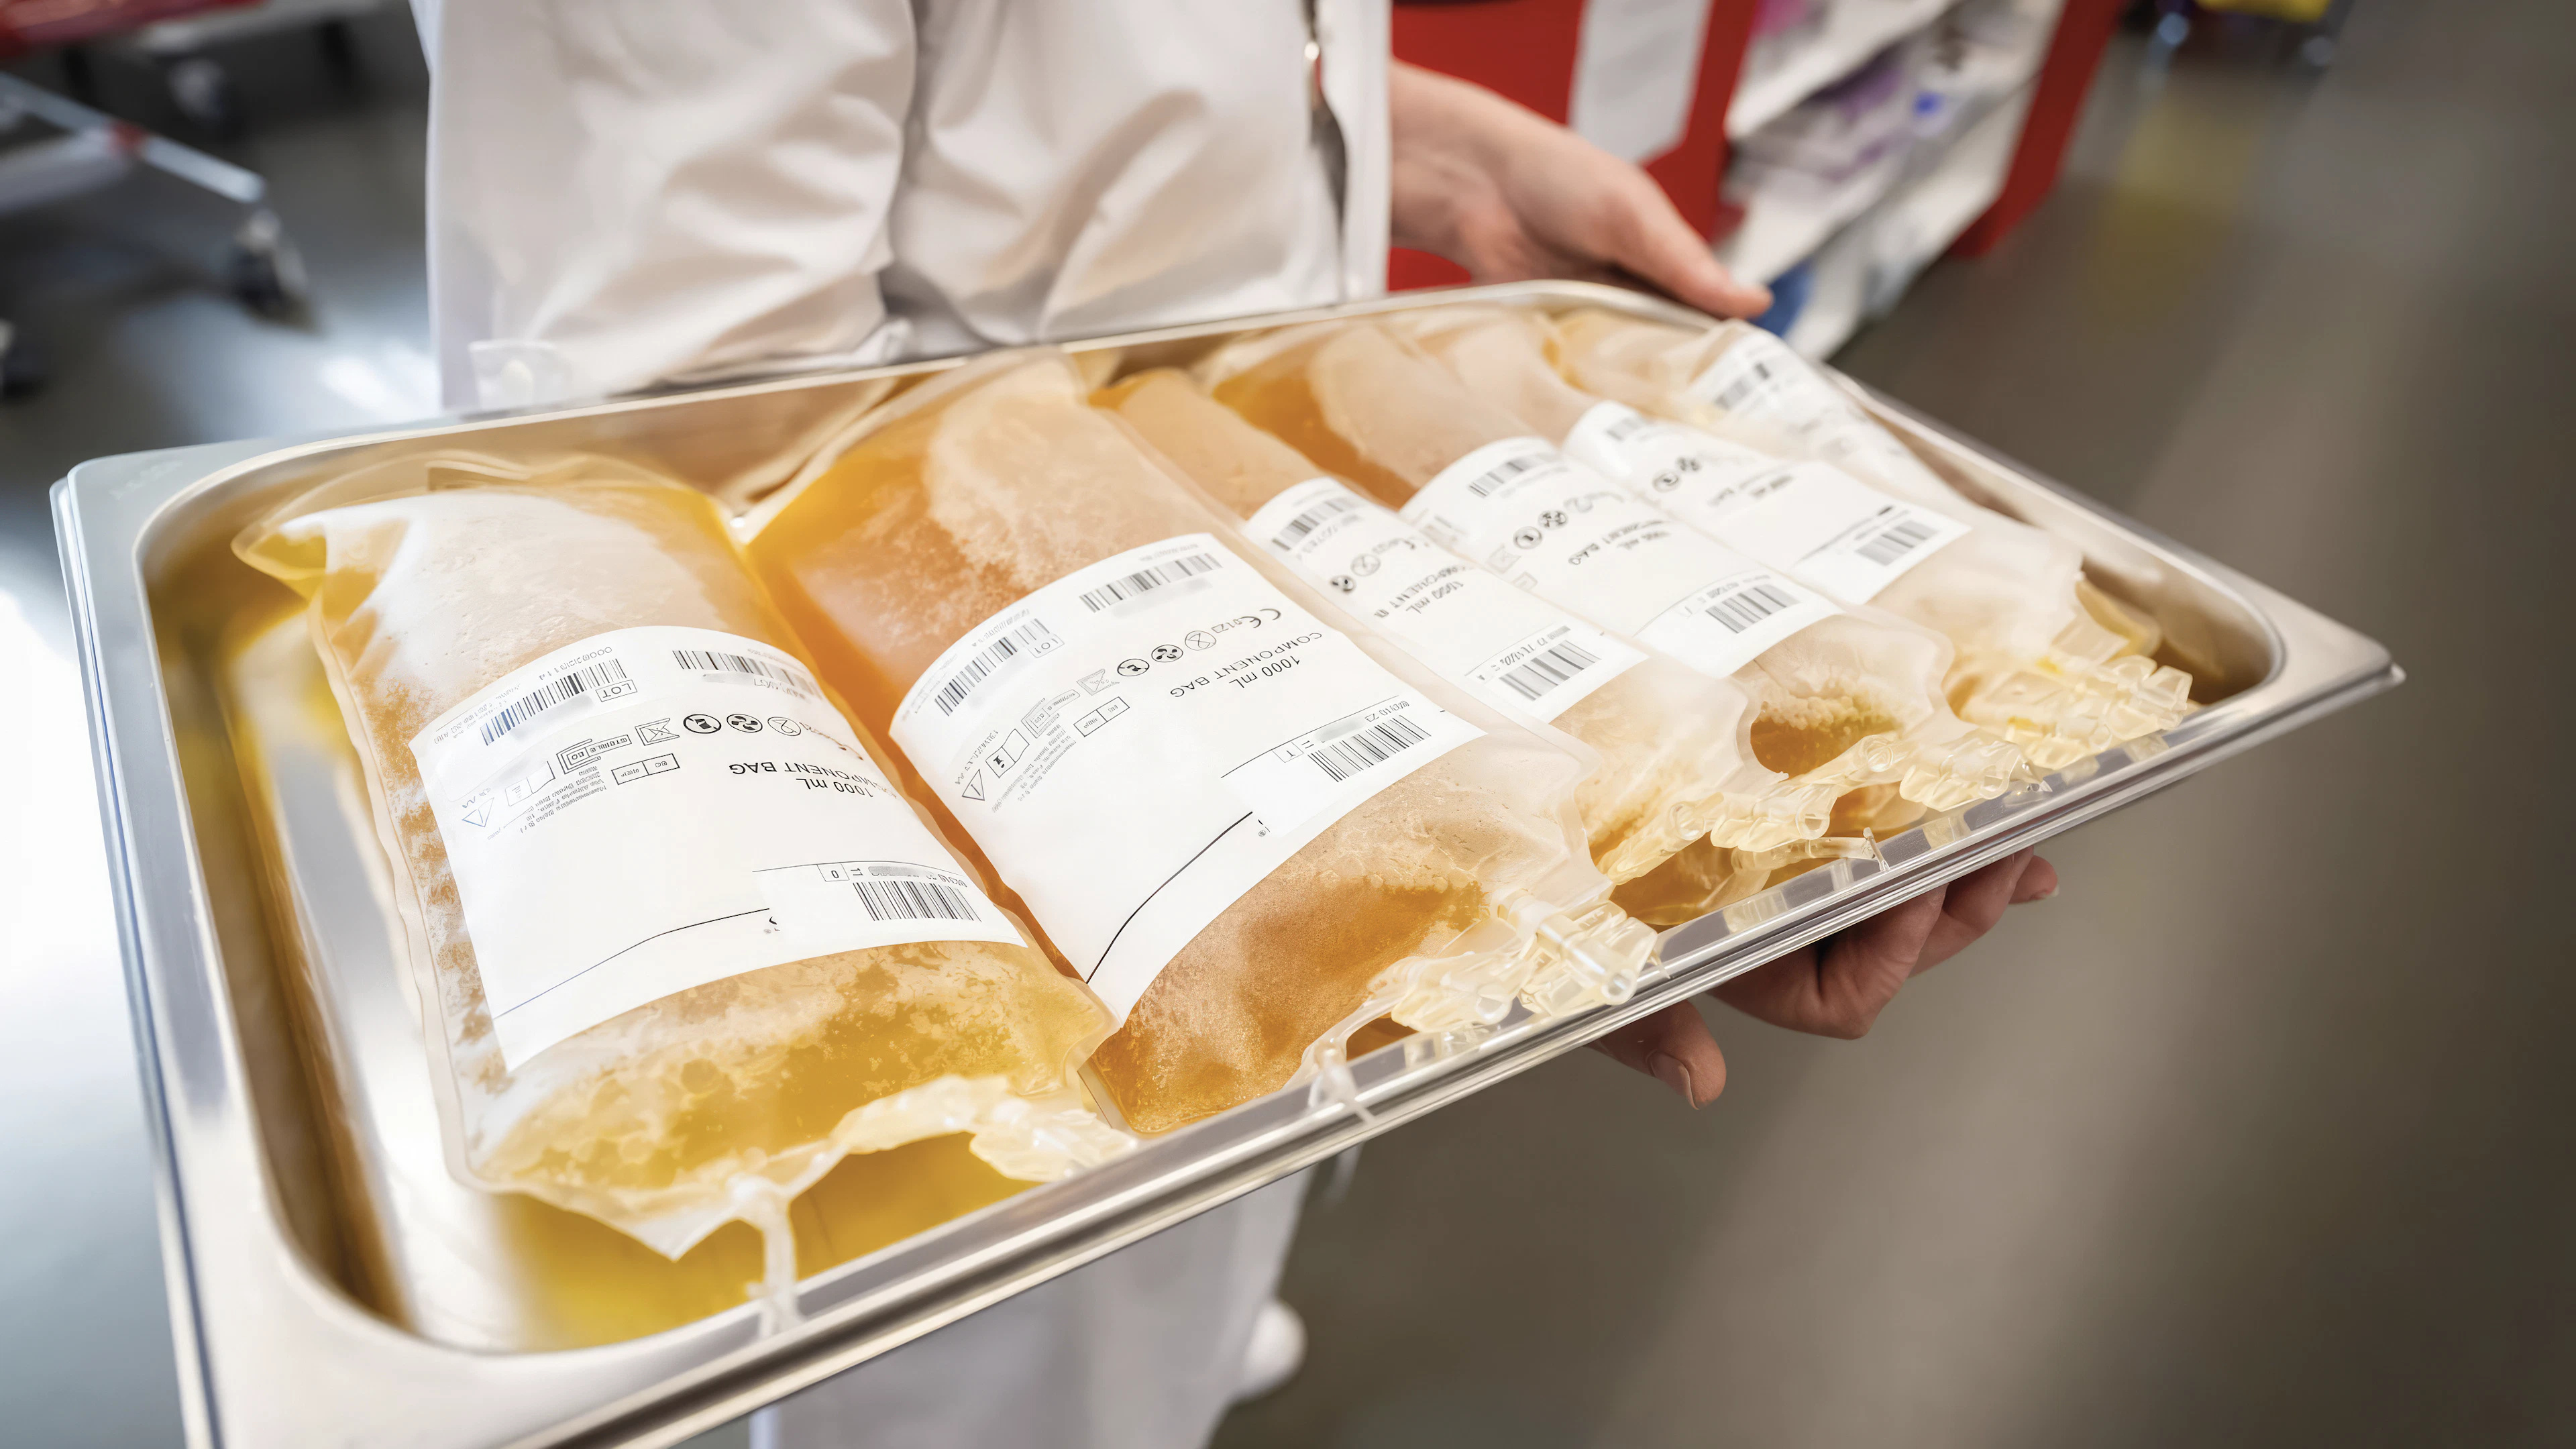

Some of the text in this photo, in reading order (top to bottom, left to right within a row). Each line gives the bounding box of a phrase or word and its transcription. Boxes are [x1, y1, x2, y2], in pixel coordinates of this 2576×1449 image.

[1170, 633, 1322, 698] COMPONENT BAG
[1228, 655, 1301, 688] 1000 mL
[602, 683, 632, 698] LOT
[729, 761, 897, 799] MPONENT BAG
[795, 777, 873, 798] 1000 mL
